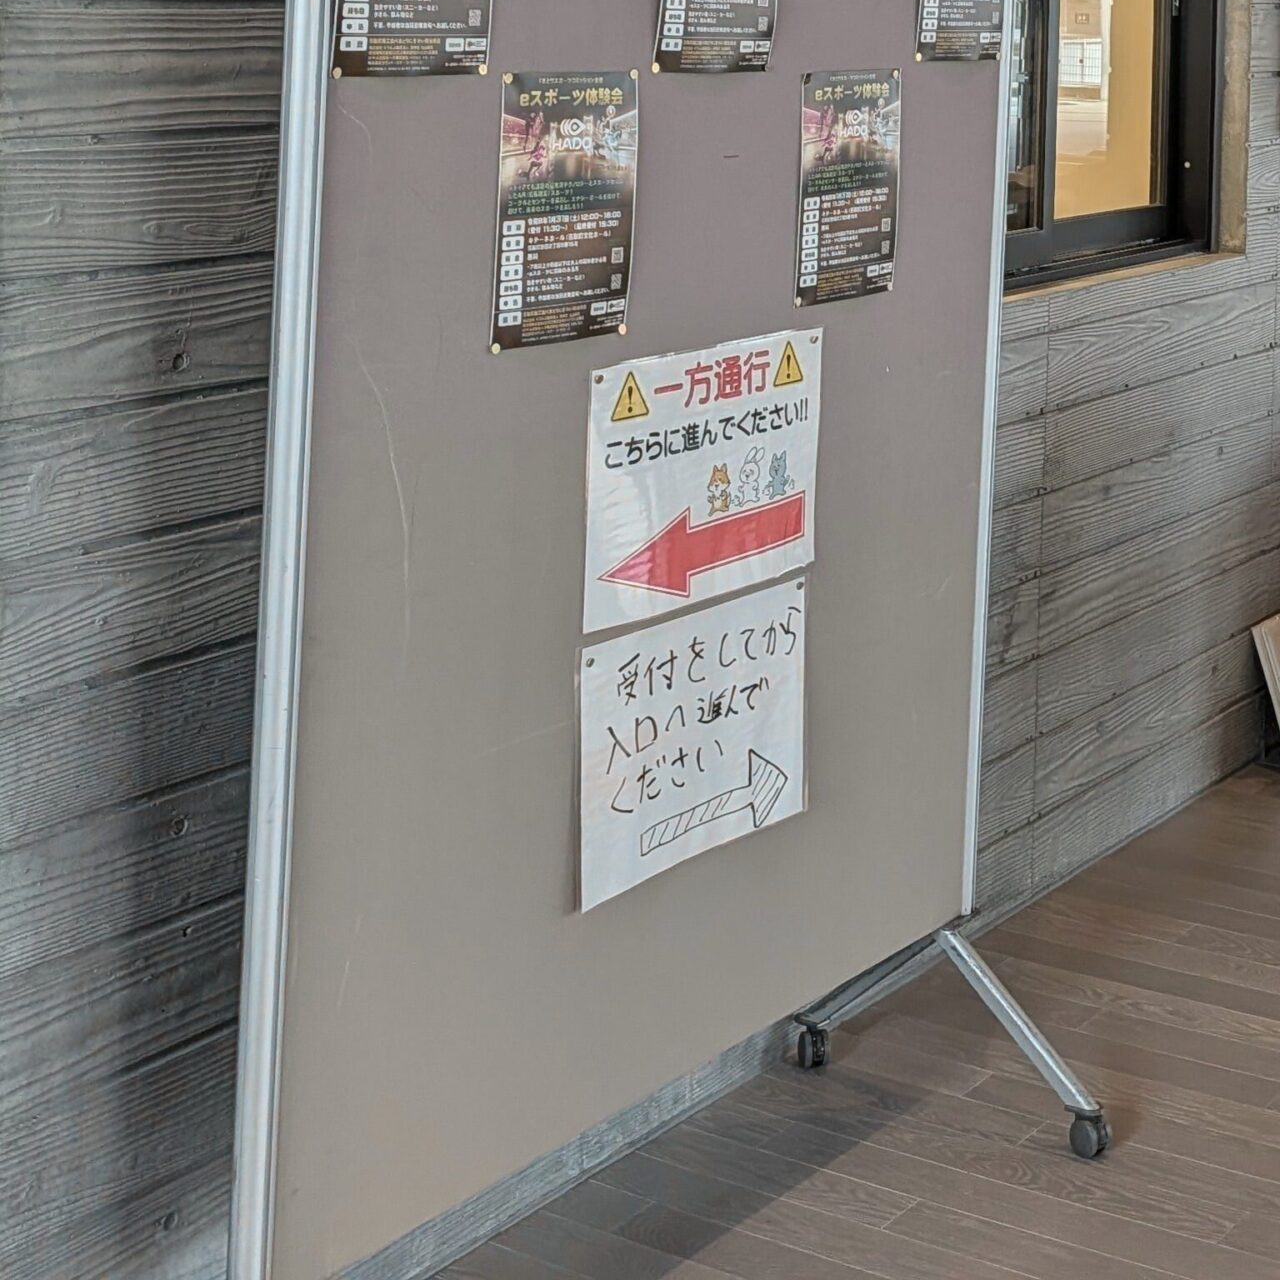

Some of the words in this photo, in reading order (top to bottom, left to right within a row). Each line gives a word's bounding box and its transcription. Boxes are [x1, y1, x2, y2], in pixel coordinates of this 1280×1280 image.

[519, 87, 624, 107] eスポーツ体験会
[815, 82, 890, 101] eスポーツ体験会
[552, 136, 593, 151] HADO
[654, 350, 771, 408] 一方通行
[605, 398, 809, 469] こちらに進んでください!!
[616, 606, 802, 707] 受付をしてから
[606, 676, 770, 775] 入口へ進んで
[611, 739, 724, 814] ください
